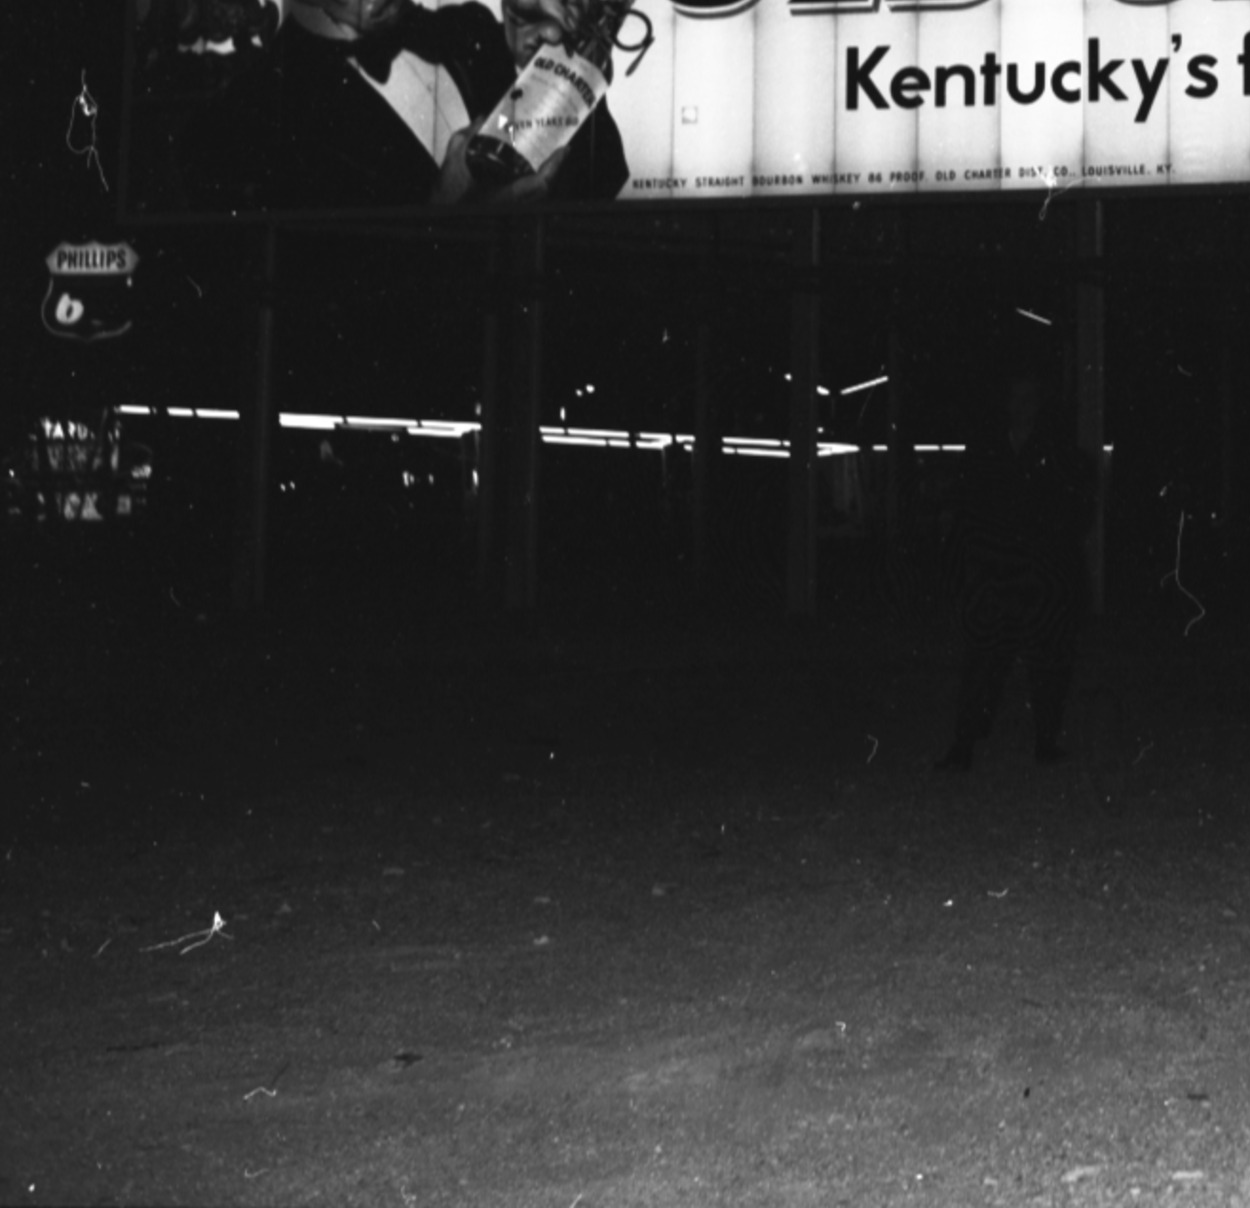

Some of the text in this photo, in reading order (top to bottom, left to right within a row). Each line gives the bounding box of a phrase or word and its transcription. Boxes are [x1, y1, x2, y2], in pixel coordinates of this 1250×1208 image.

[845, 32, 1220, 123] Kentucky's
[632, 178, 687, 190] KENTUCKY
[695, 176, 745, 188] STRAIGHT
[752, 174, 804, 187] BOURBON
[811, 172, 861, 185] WHISKEY
[868, 171, 883, 184] 86
[936, 169, 957, 182] OLD
[964, 167, 1012, 181] CHARTER
[56, 249, 128, 270] PHILLIPS
